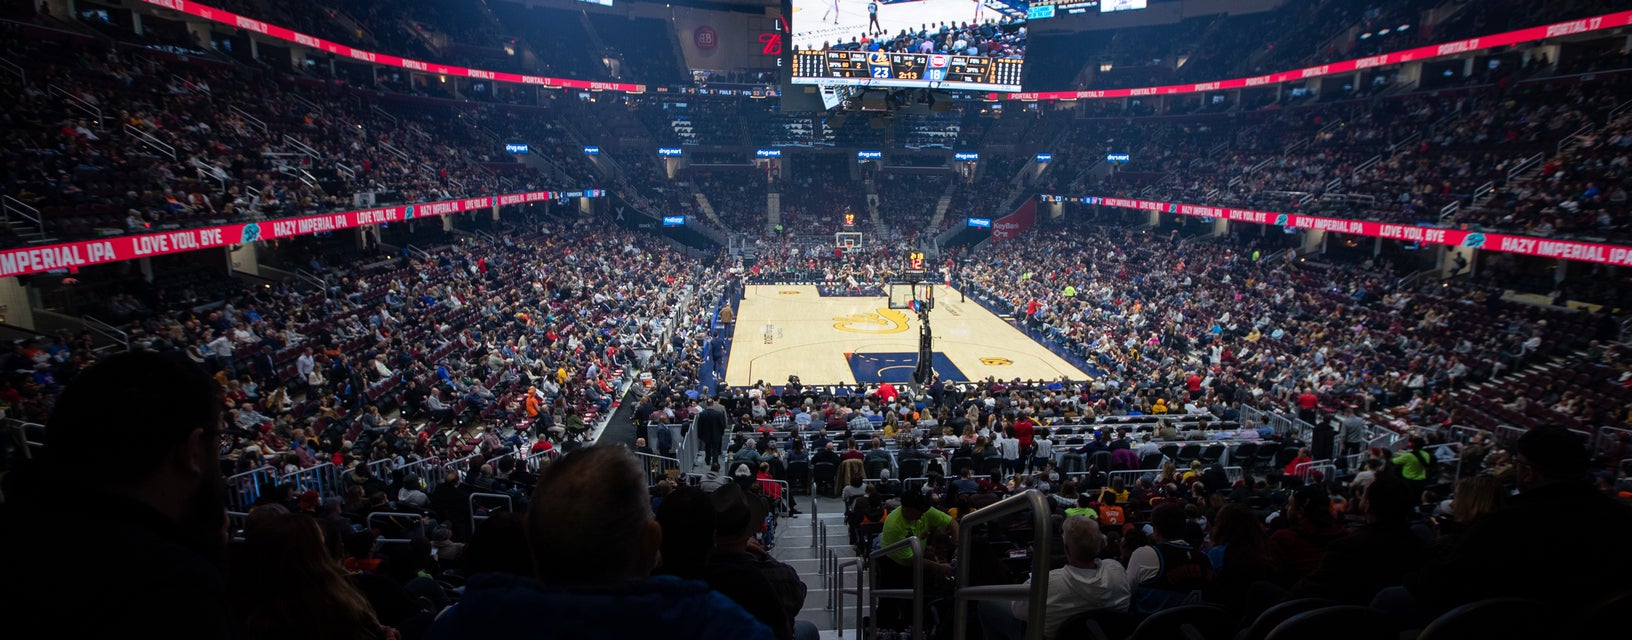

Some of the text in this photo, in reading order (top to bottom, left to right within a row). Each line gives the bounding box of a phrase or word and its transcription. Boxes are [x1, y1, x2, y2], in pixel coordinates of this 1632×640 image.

[1546, 16, 1602, 37] PORTAL 17
[1437, 39, 1480, 56] PORTAL 17
[402, 59, 421, 70] PORTAL
[1356, 56, 1380, 69] PORTAL
[468, 69, 488, 78] PORTAL
[874, 67, 889, 78] 23
[930, 69, 940, 80] 18
[1302, 67, 1322, 77] PORTAL
[522, 76, 544, 84] PORTAL
[1245, 77, 1264, 86] PORTAL
[1194, 83, 1214, 91] PORTAL
[356, 212, 372, 224] LOVE
[386, 209, 396, 220] BYE
[1182, 206, 1222, 218] HAZY IMPERIAL IPA
[1230, 210, 1243, 220] LOVE
[1255, 213, 1266, 222] BYE
[274, 214, 347, 236] HAZY IMPERIAL IPA
[1296, 216, 1363, 234] HAZY IMPERIAL IPA
[1380, 224, 1402, 238] LOVE
[1425, 229, 1445, 243] BYE
[132, 228, 223, 255] LOVE YOU, BYE
[1501, 237, 1632, 264] HAZY IMPERIAL IPA
[0, 241, 116, 275] MPERIAL IPA
